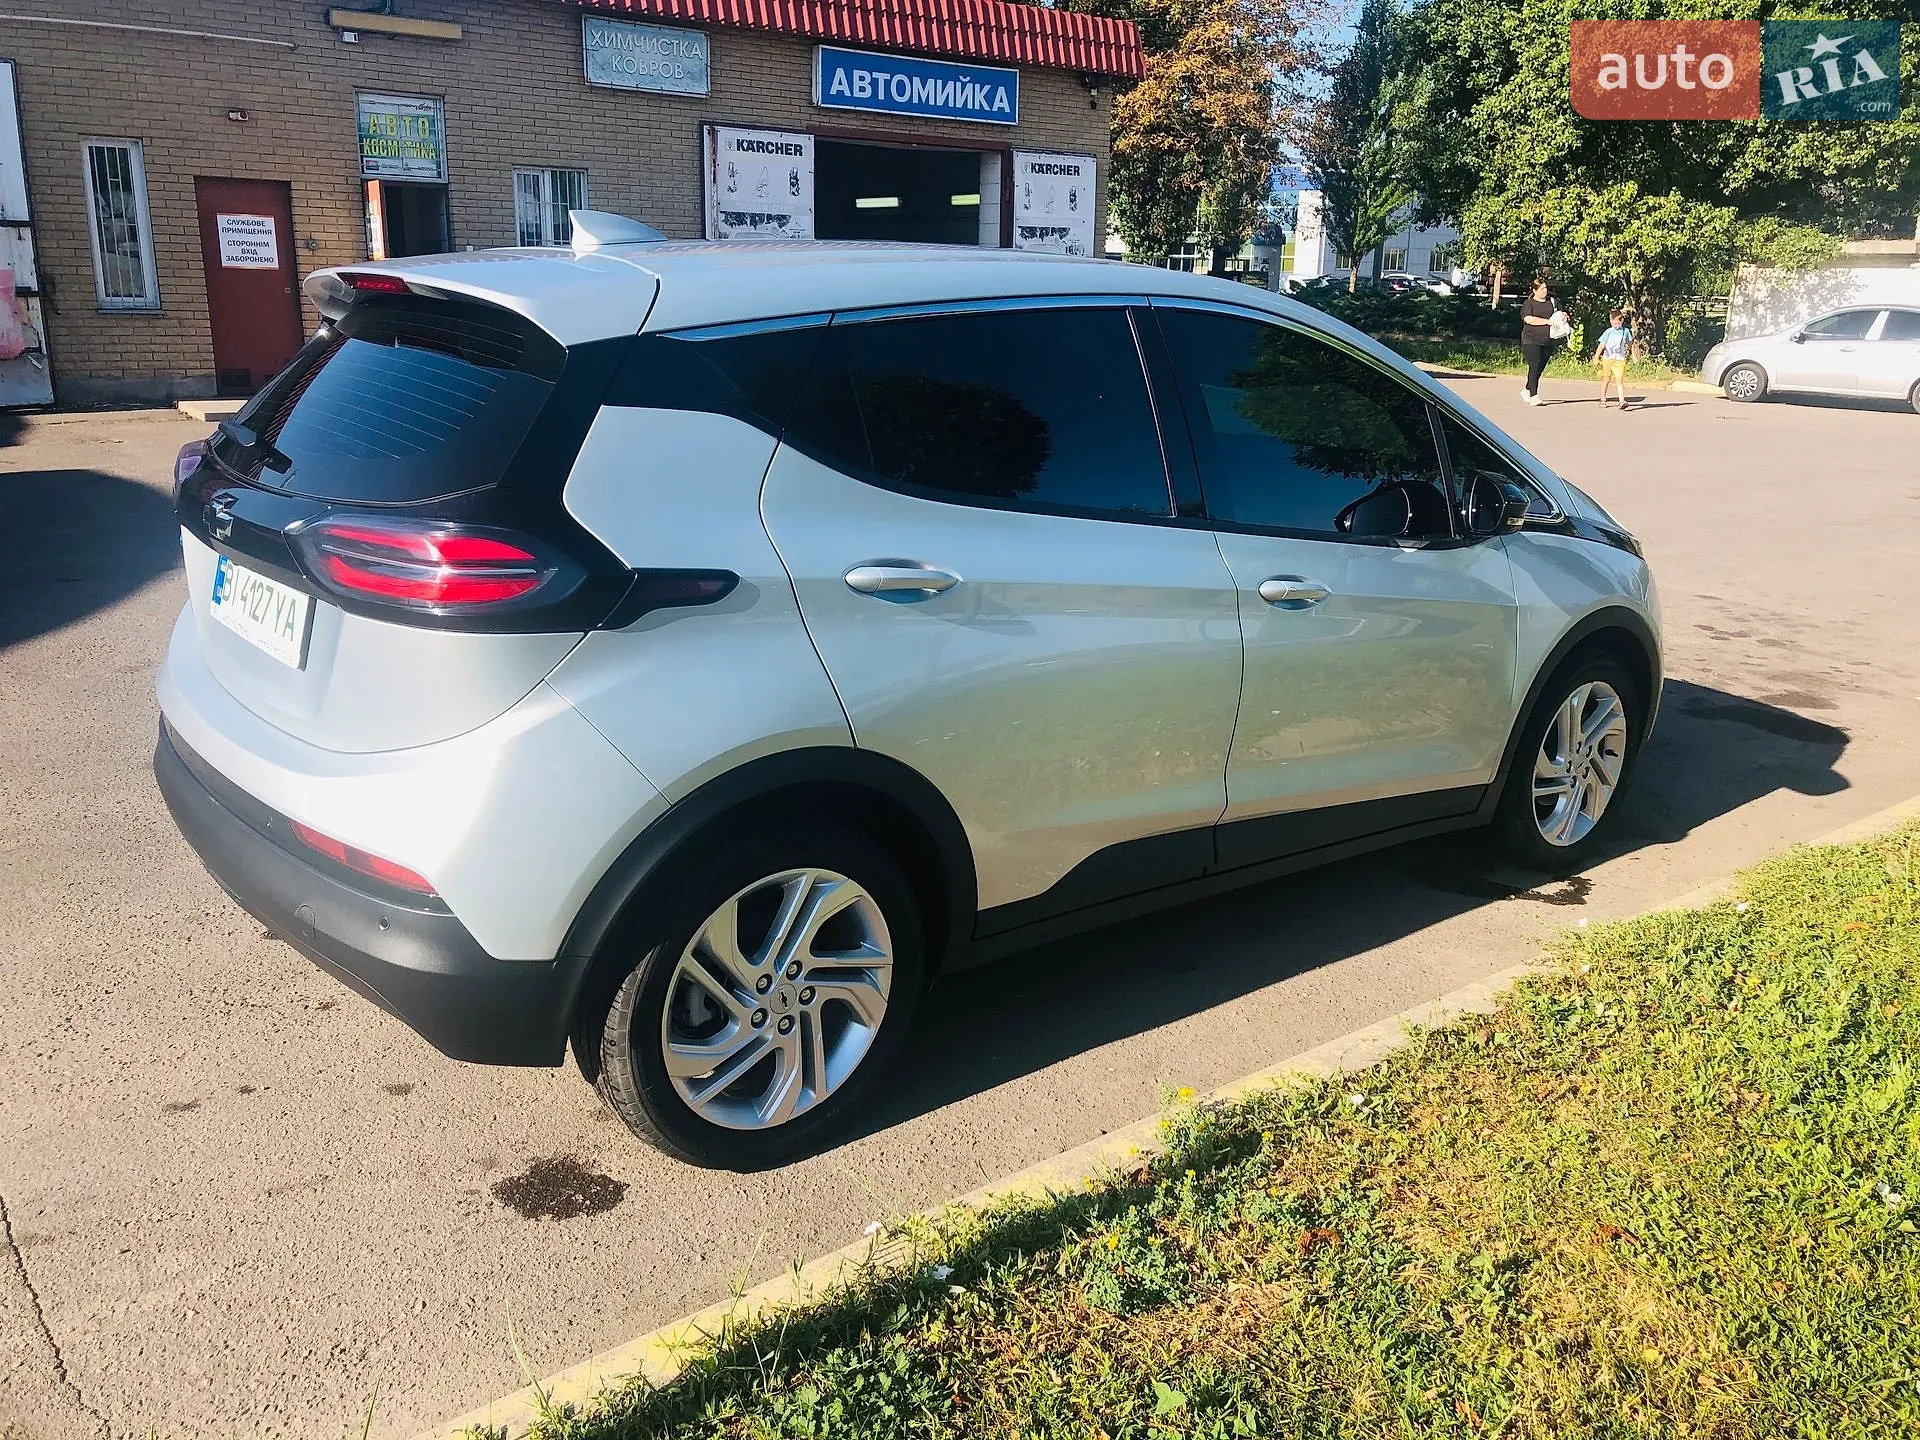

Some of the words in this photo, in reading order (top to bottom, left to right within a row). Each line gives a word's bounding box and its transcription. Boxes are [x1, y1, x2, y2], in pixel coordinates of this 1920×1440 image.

[591, 29, 702, 60] ХИМЧИСТКА
[829, 67, 1011, 113] АВТОМИЙКА
[368, 112, 430, 140] АВТО
[736, 138, 804, 156] KÄRCHER
[1030, 162, 1081, 176] KÄRCHER
[226, 218, 266, 227] СЛУЖБОВЕ
[221, 227, 272, 235] ПРИМІЩЕННЯ
[227, 239, 270, 248] СТОРОННІМ
[225, 255, 274, 263] ЗАБОРОНЕНО
[241, 248, 258, 256] ВХІД
[222, 563, 240, 606] BI
[240, 575, 274, 625] 4127
[274, 590, 297, 642] YA
